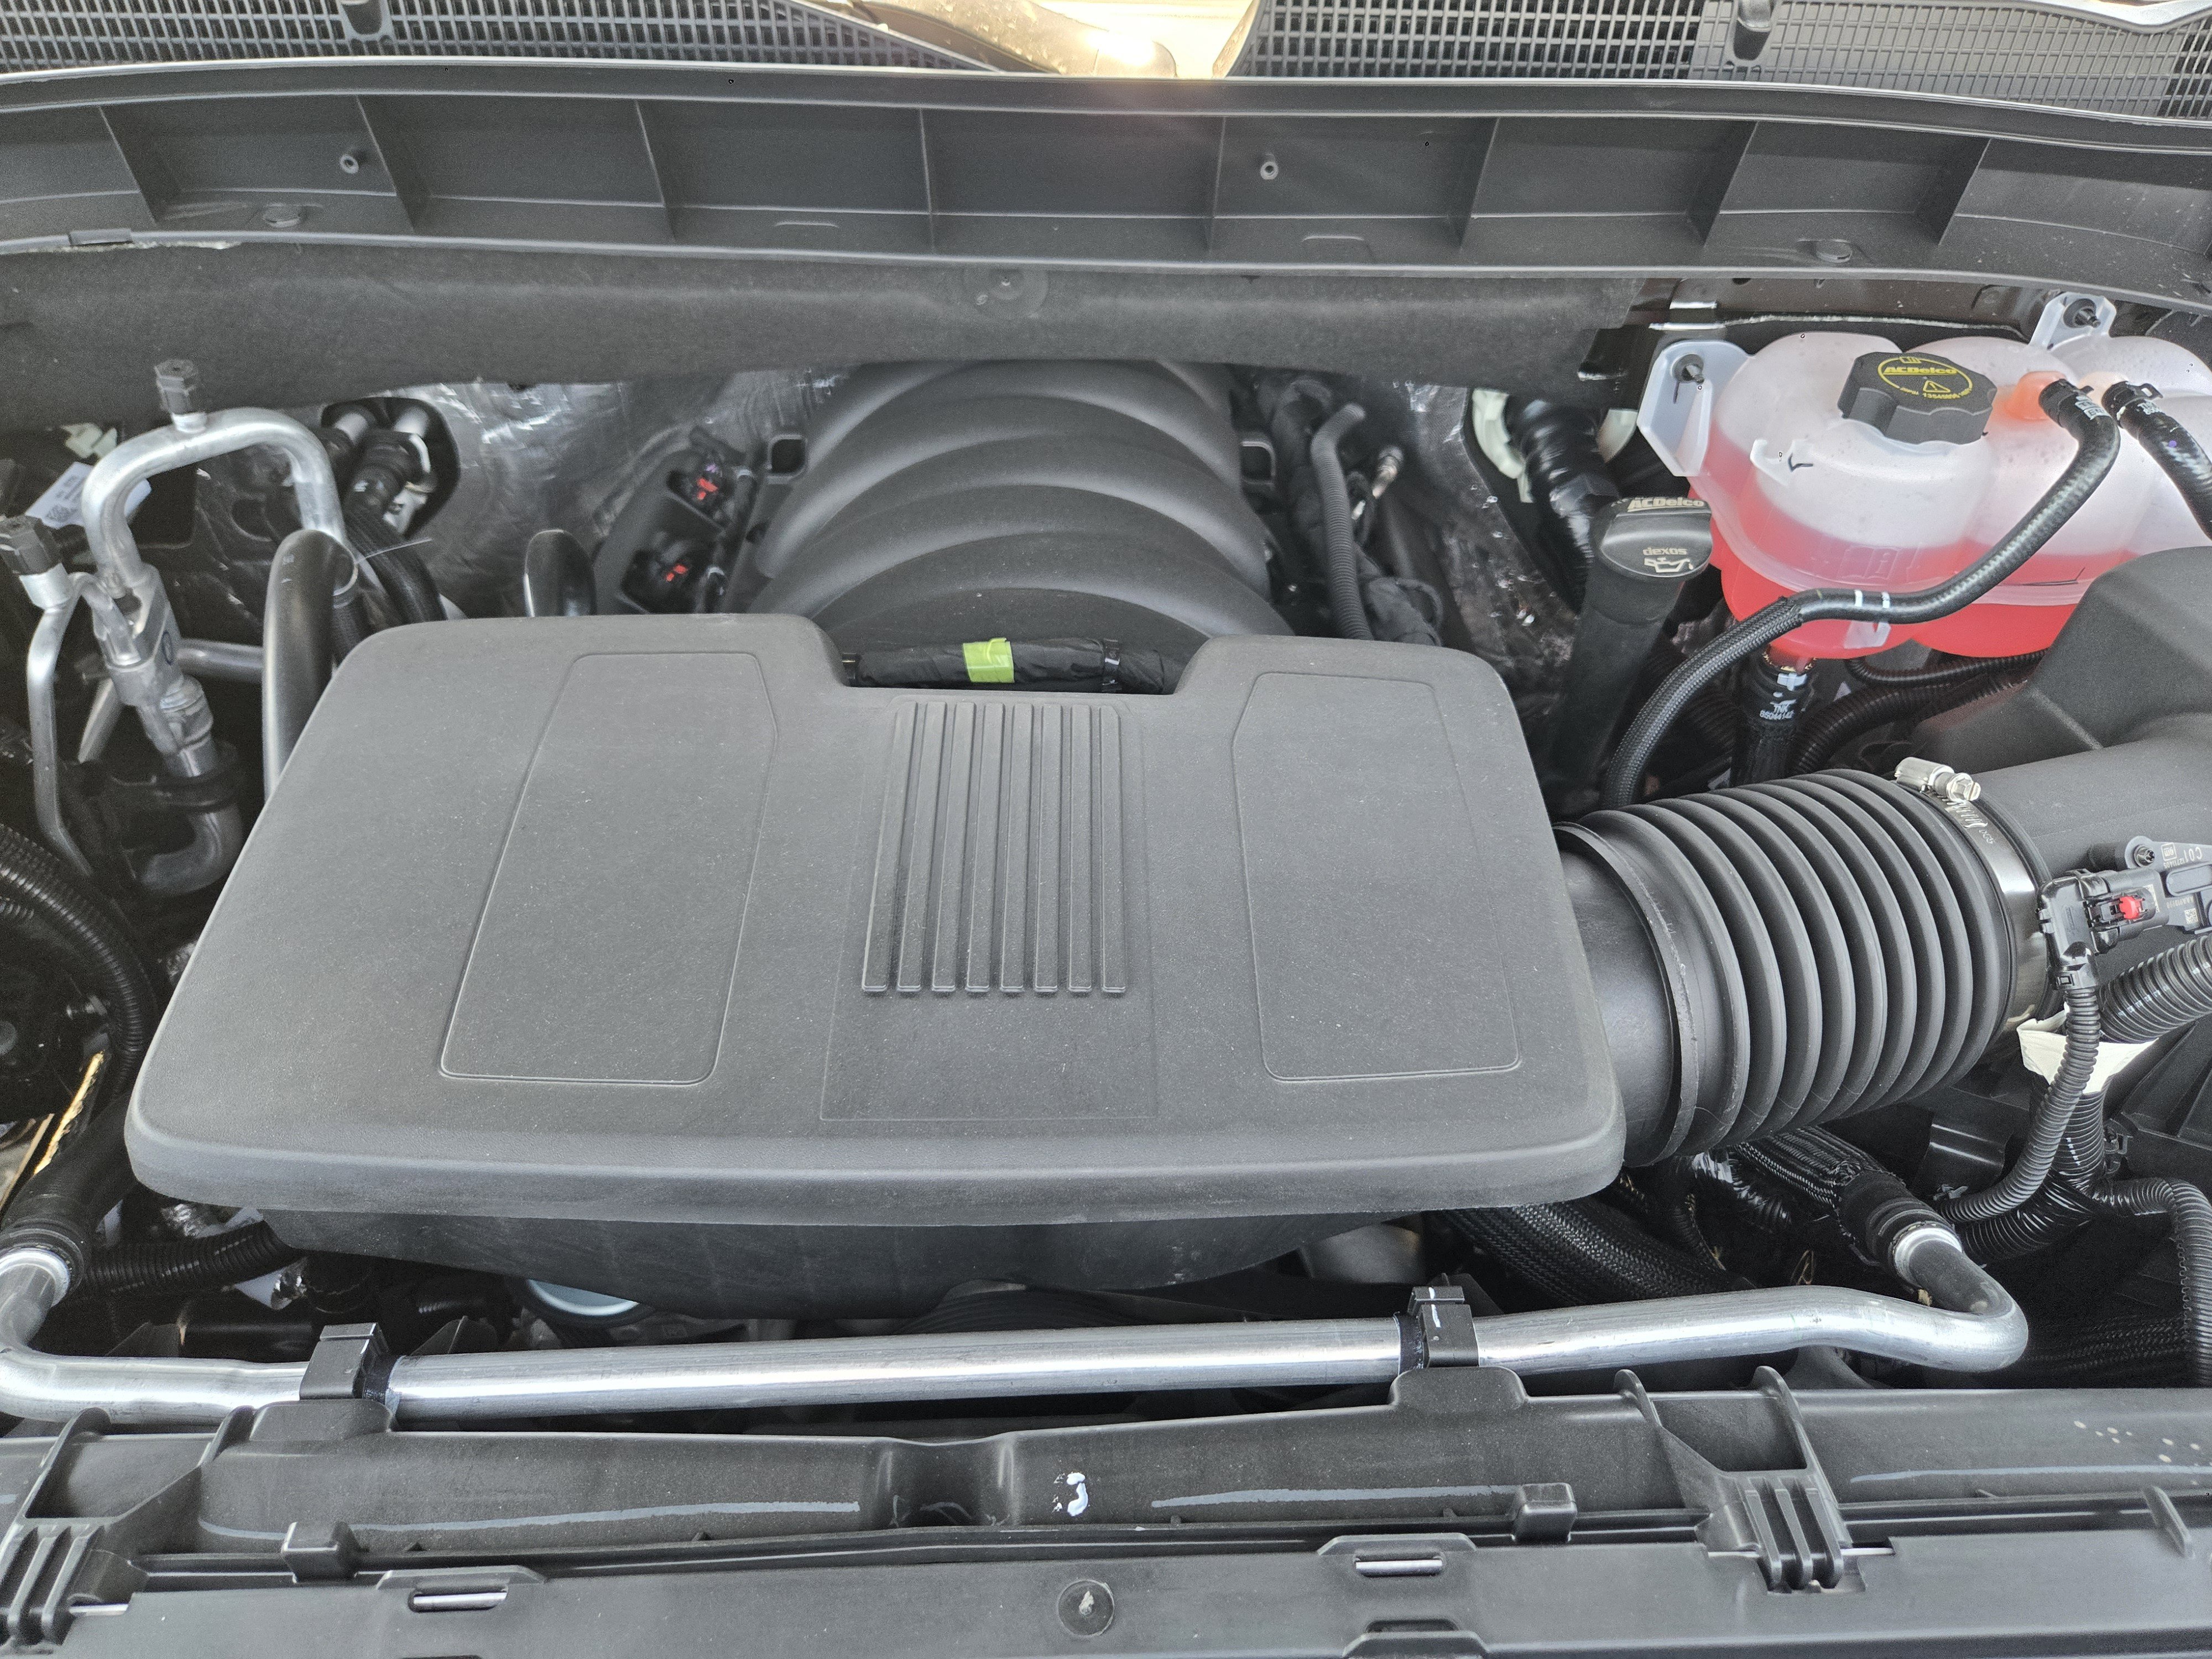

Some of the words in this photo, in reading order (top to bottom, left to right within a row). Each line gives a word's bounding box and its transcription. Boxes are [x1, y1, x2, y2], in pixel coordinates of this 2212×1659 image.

[1883, 366, 1958, 374] ACDelco
[1627, 497, 1704, 510] ACDelco
[1642, 546, 1687, 556] dexos
[2184, 847, 2202, 862] C01
